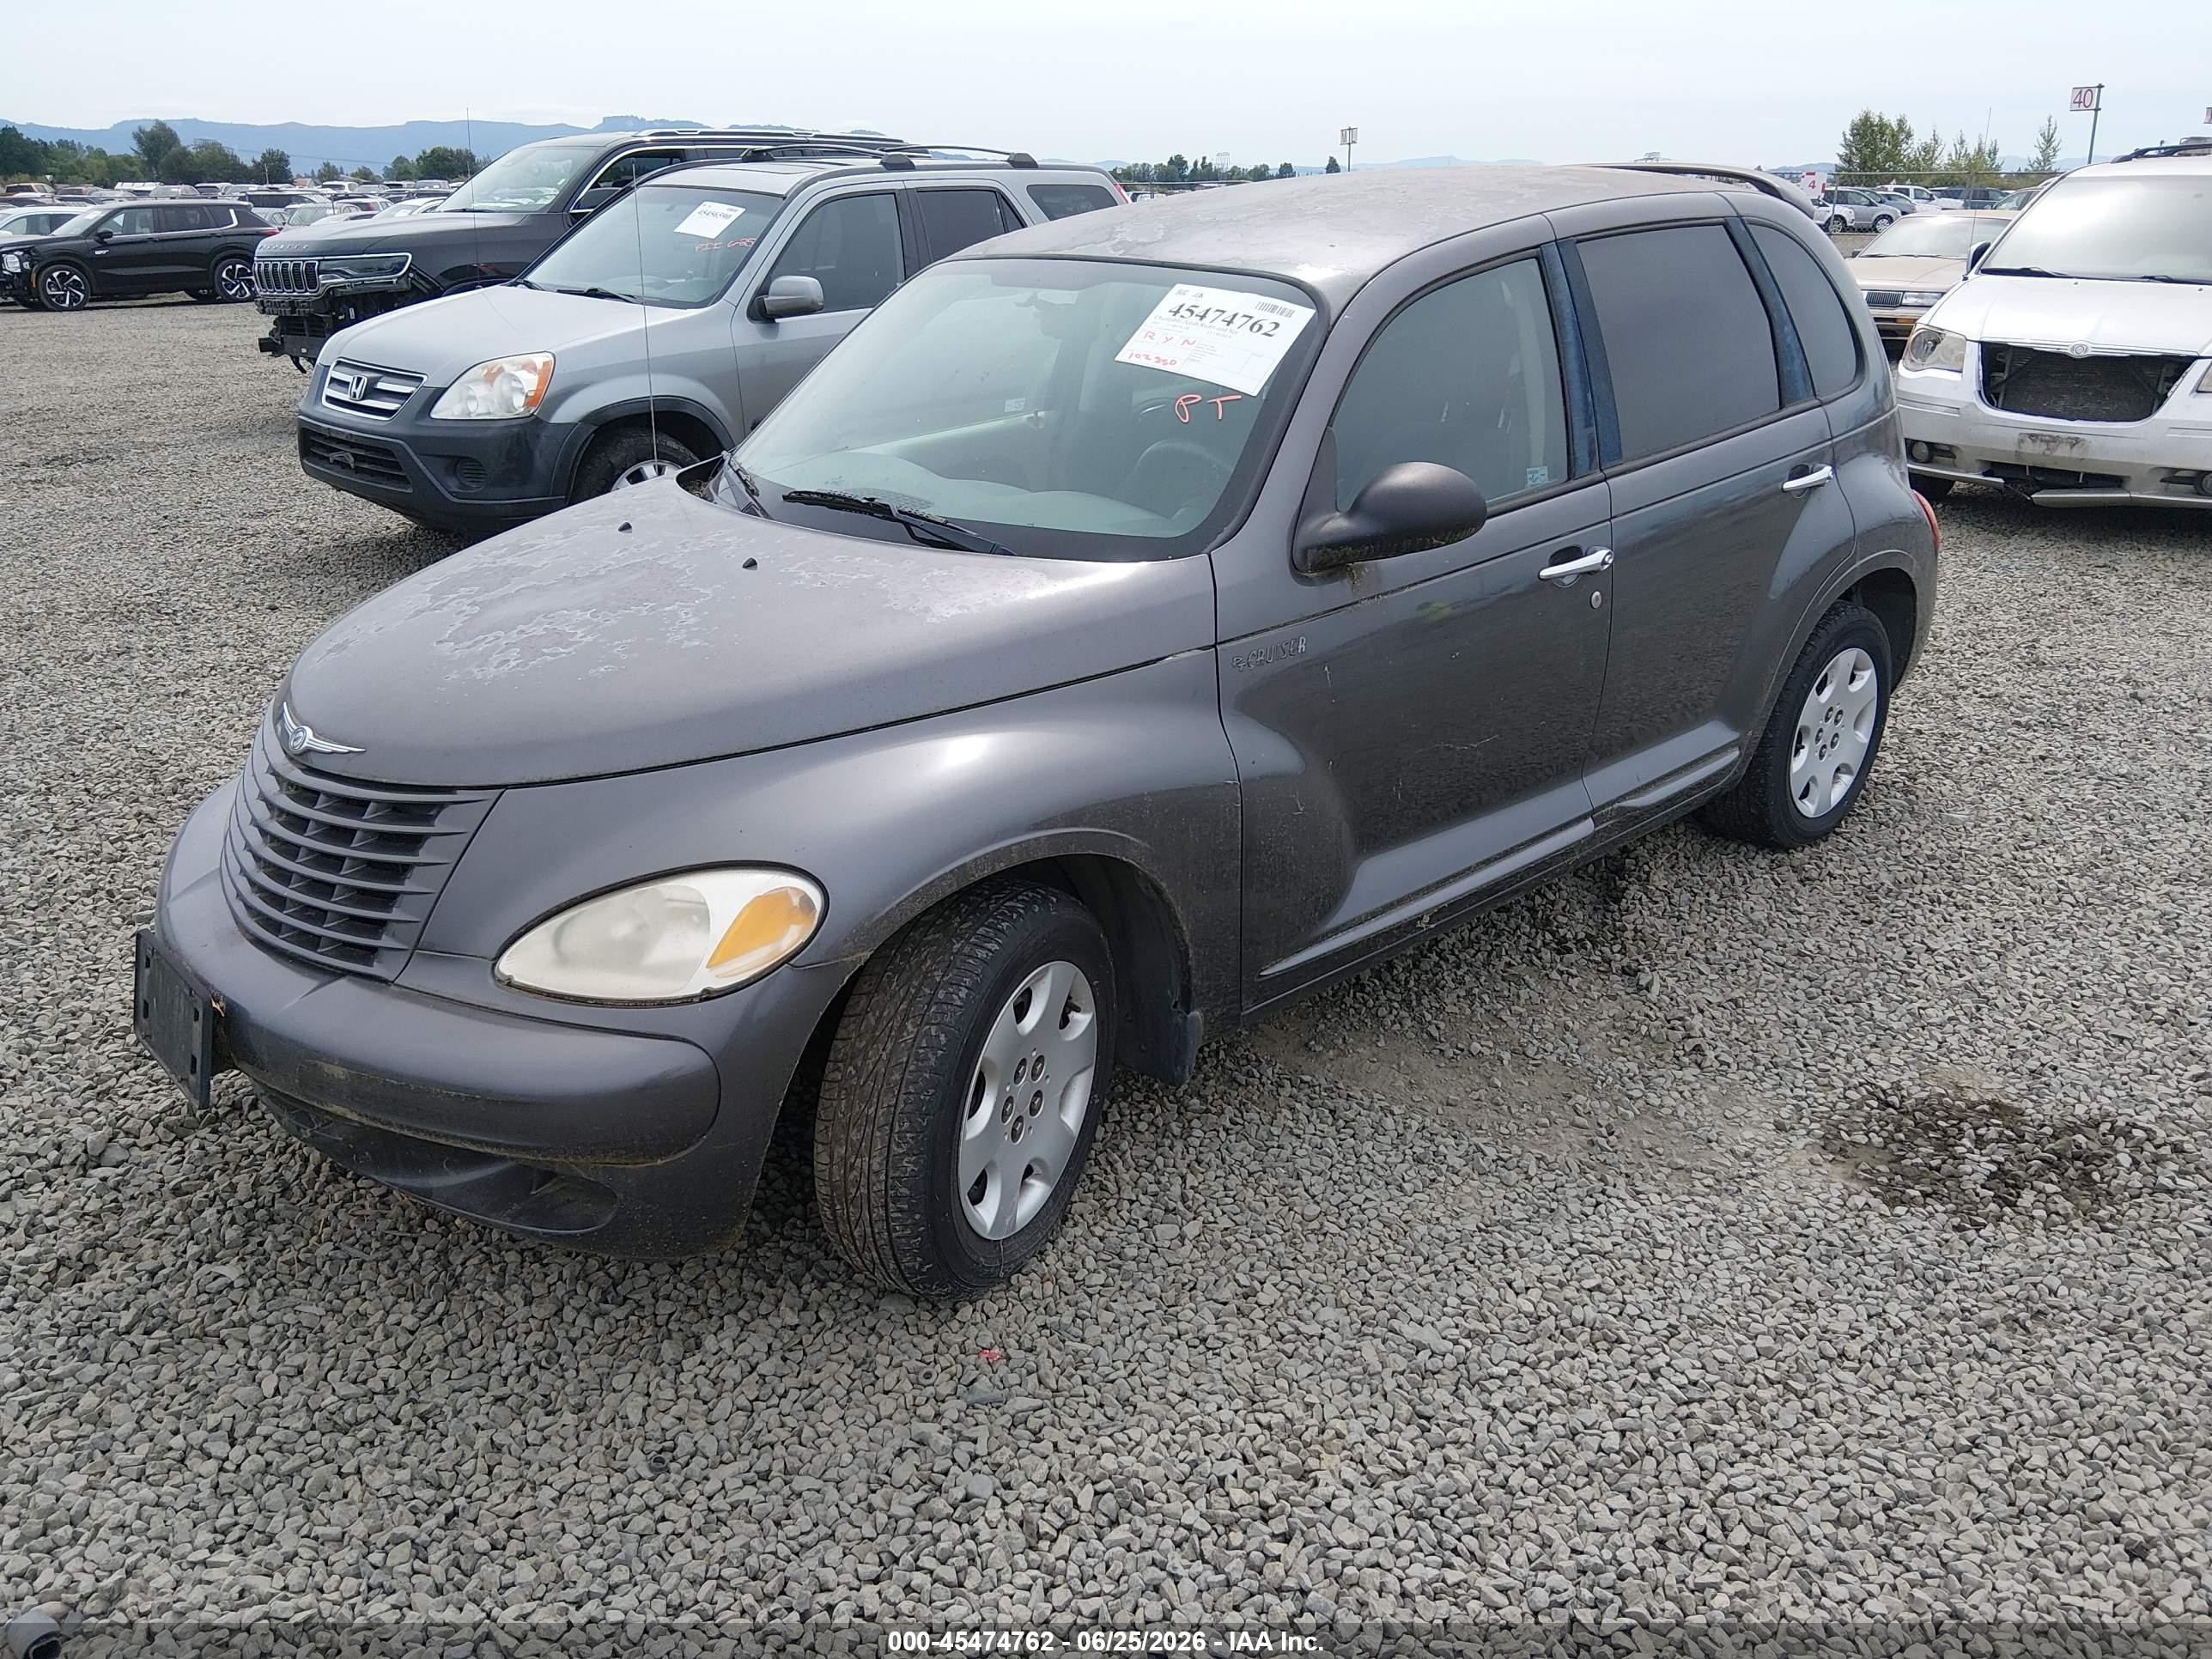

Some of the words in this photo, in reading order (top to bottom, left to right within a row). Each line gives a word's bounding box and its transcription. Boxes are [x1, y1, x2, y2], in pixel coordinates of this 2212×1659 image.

[2072, 88, 2094, 109] 40
[1808, 179, 1816, 190] 4
[1168, 302, 1281, 337] 45474762
[1143, 331, 1156, 341] R
